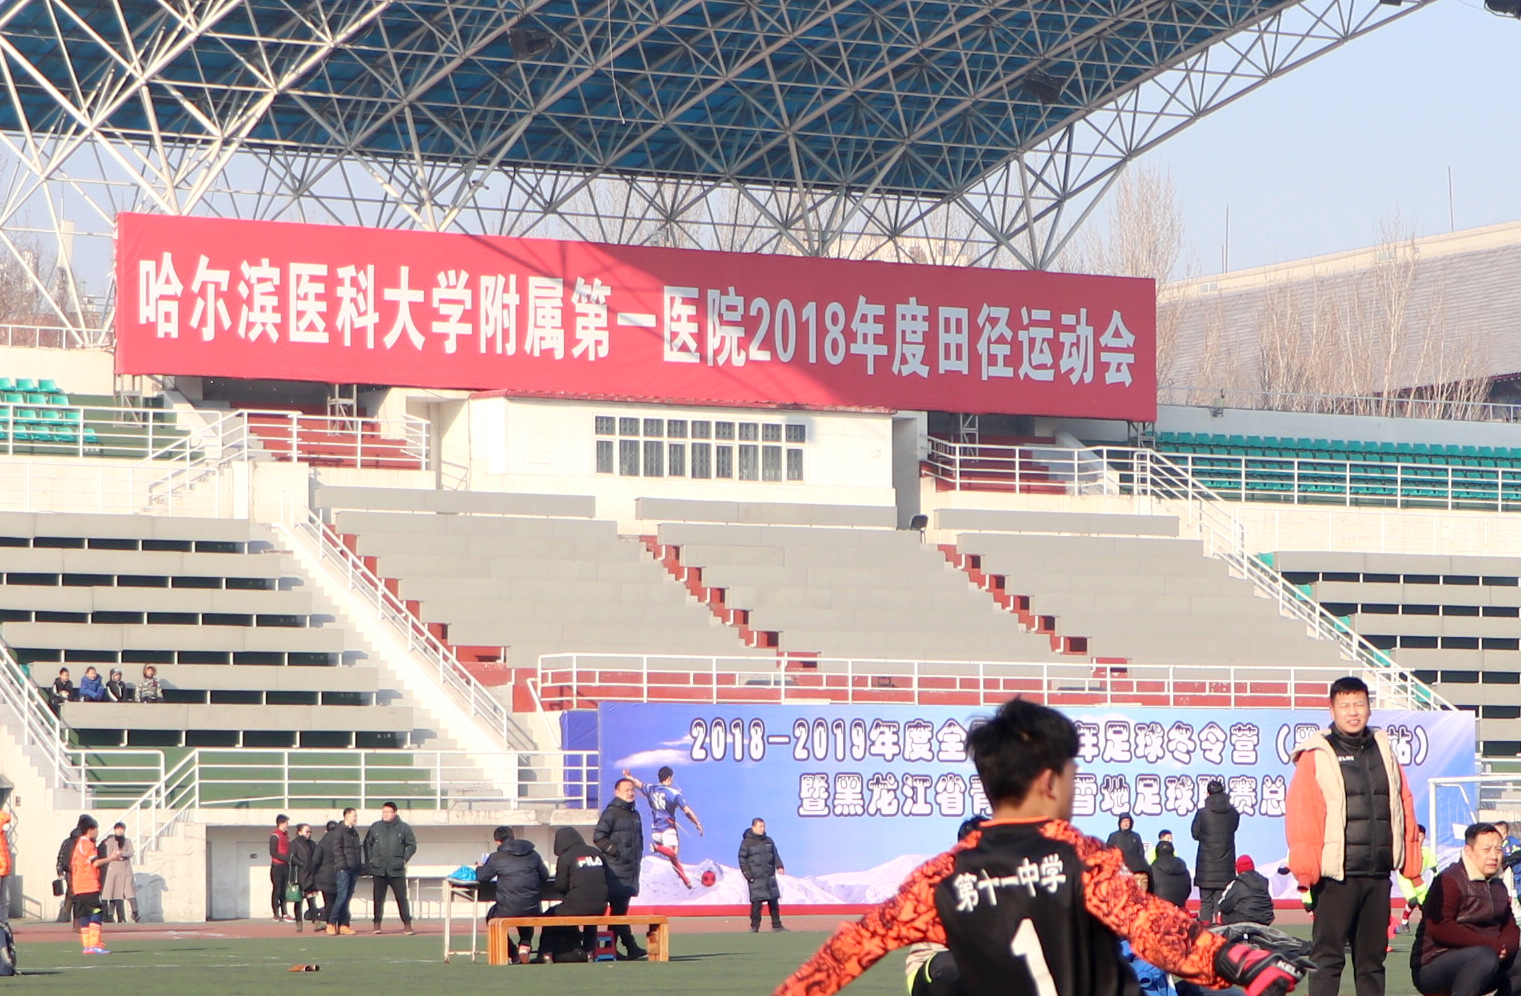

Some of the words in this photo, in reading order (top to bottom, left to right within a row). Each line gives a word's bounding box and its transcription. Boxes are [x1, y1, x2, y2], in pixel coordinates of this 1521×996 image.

[138, 251, 1136, 388] 哈尔滨医科大学附属第一医院2018年度田径运动会
[577, 856, 603, 868] FILA
[953, 852, 1067, 912] 第十一中学
